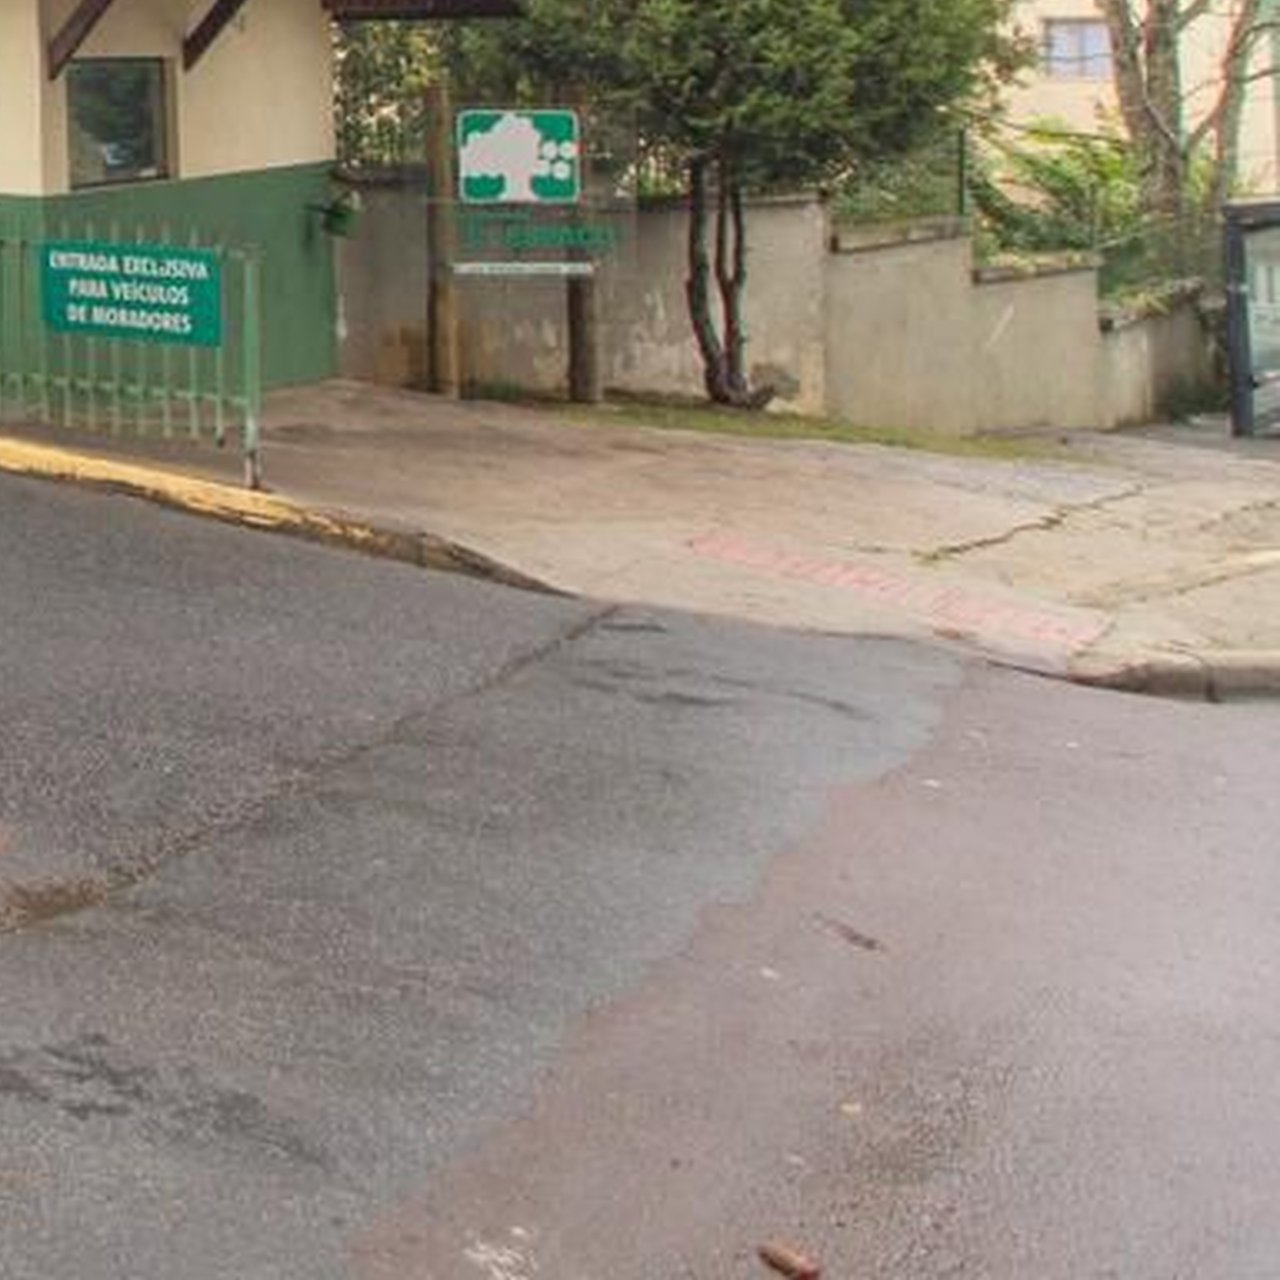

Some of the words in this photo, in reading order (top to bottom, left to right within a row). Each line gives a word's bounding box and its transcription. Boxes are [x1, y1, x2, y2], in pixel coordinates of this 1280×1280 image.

[49, 250, 119, 273] ENTRADA
[122, 255, 209, 280] EXCLUSIVA
[68, 278, 108, 299] PARA
[110, 280, 189, 305] VEÍCULOS
[66, 304, 87, 323] DE
[92, 306, 192, 334] MORADORES
